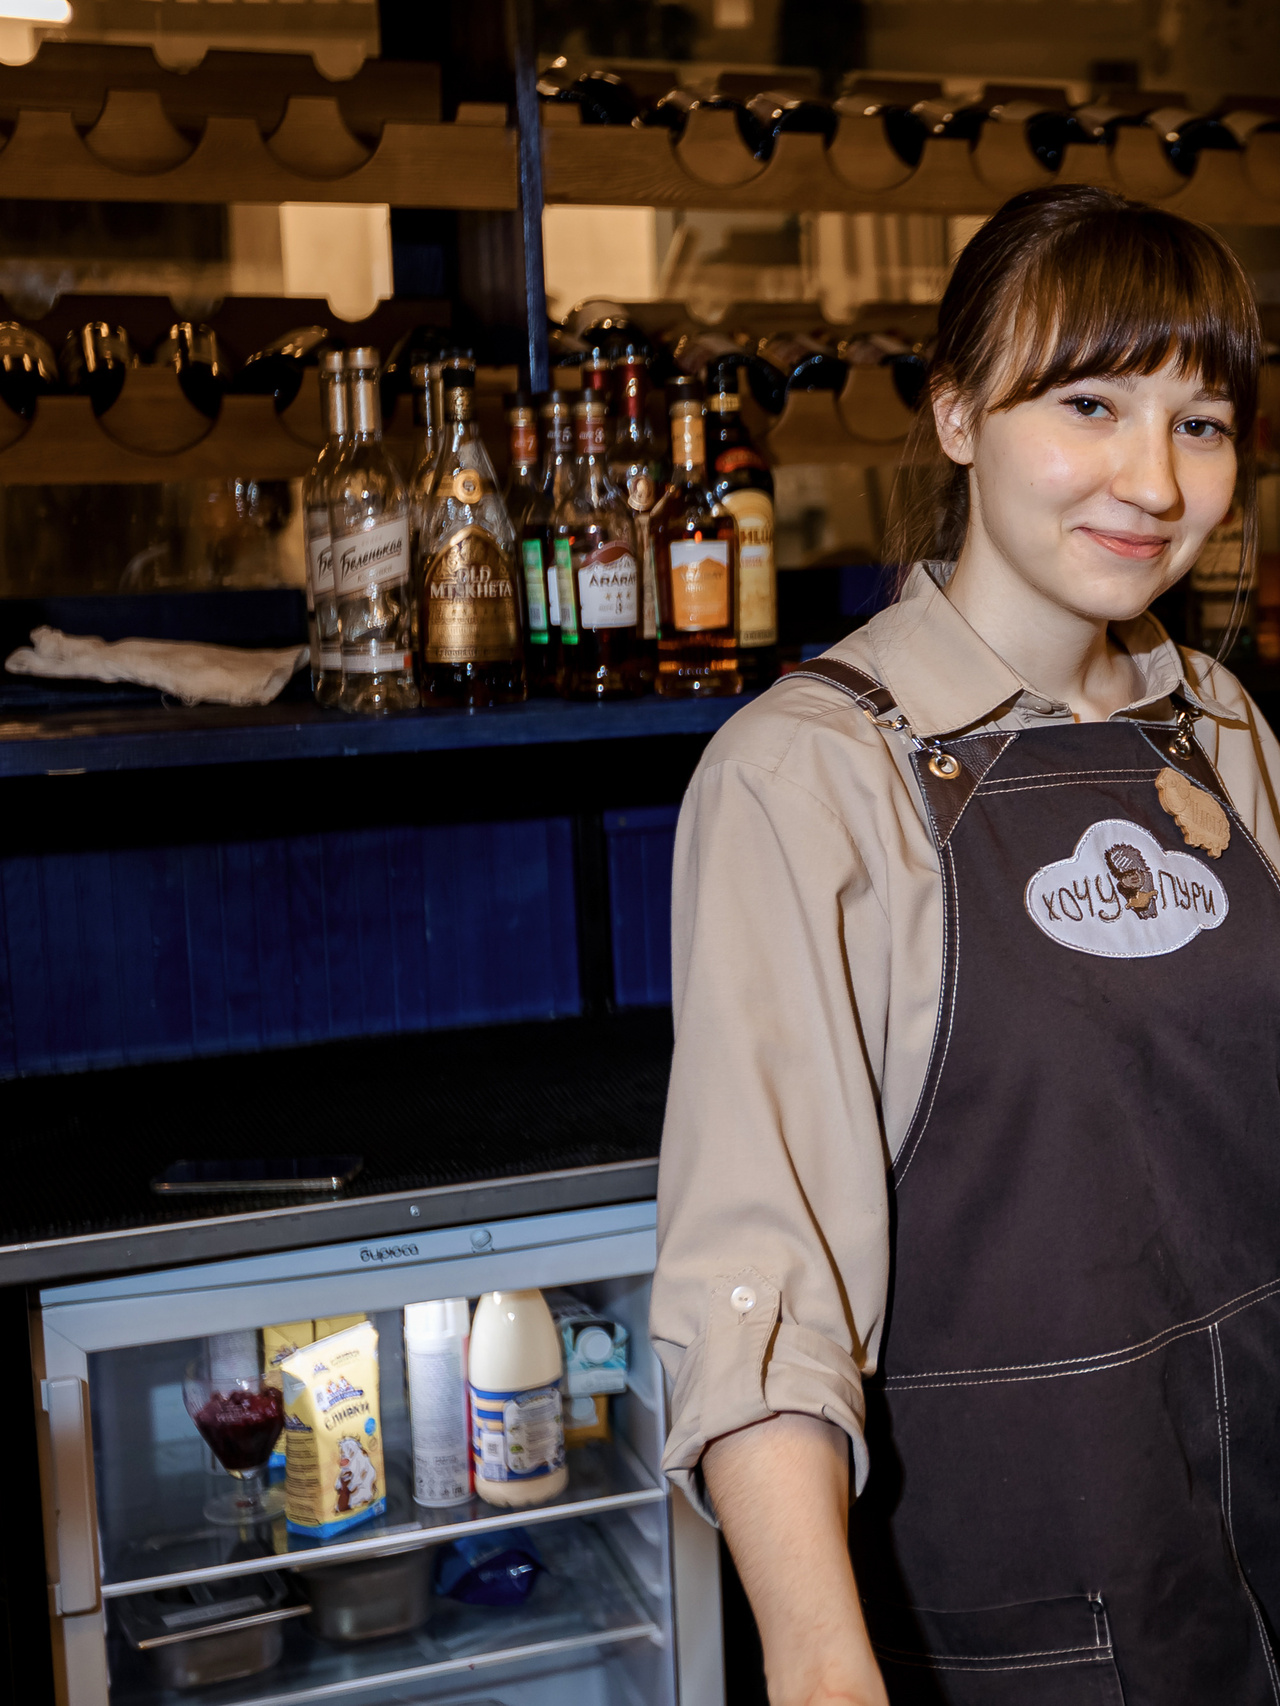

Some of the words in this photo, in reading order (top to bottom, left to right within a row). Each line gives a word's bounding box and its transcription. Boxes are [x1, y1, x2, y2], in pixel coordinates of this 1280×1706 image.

[340, 537, 402, 583] Беленькая
[457, 565, 491, 583] OLD
[1042, 873, 1122, 922] ХОЧУ
[1157, 869, 1217, 917] ПУРИ
